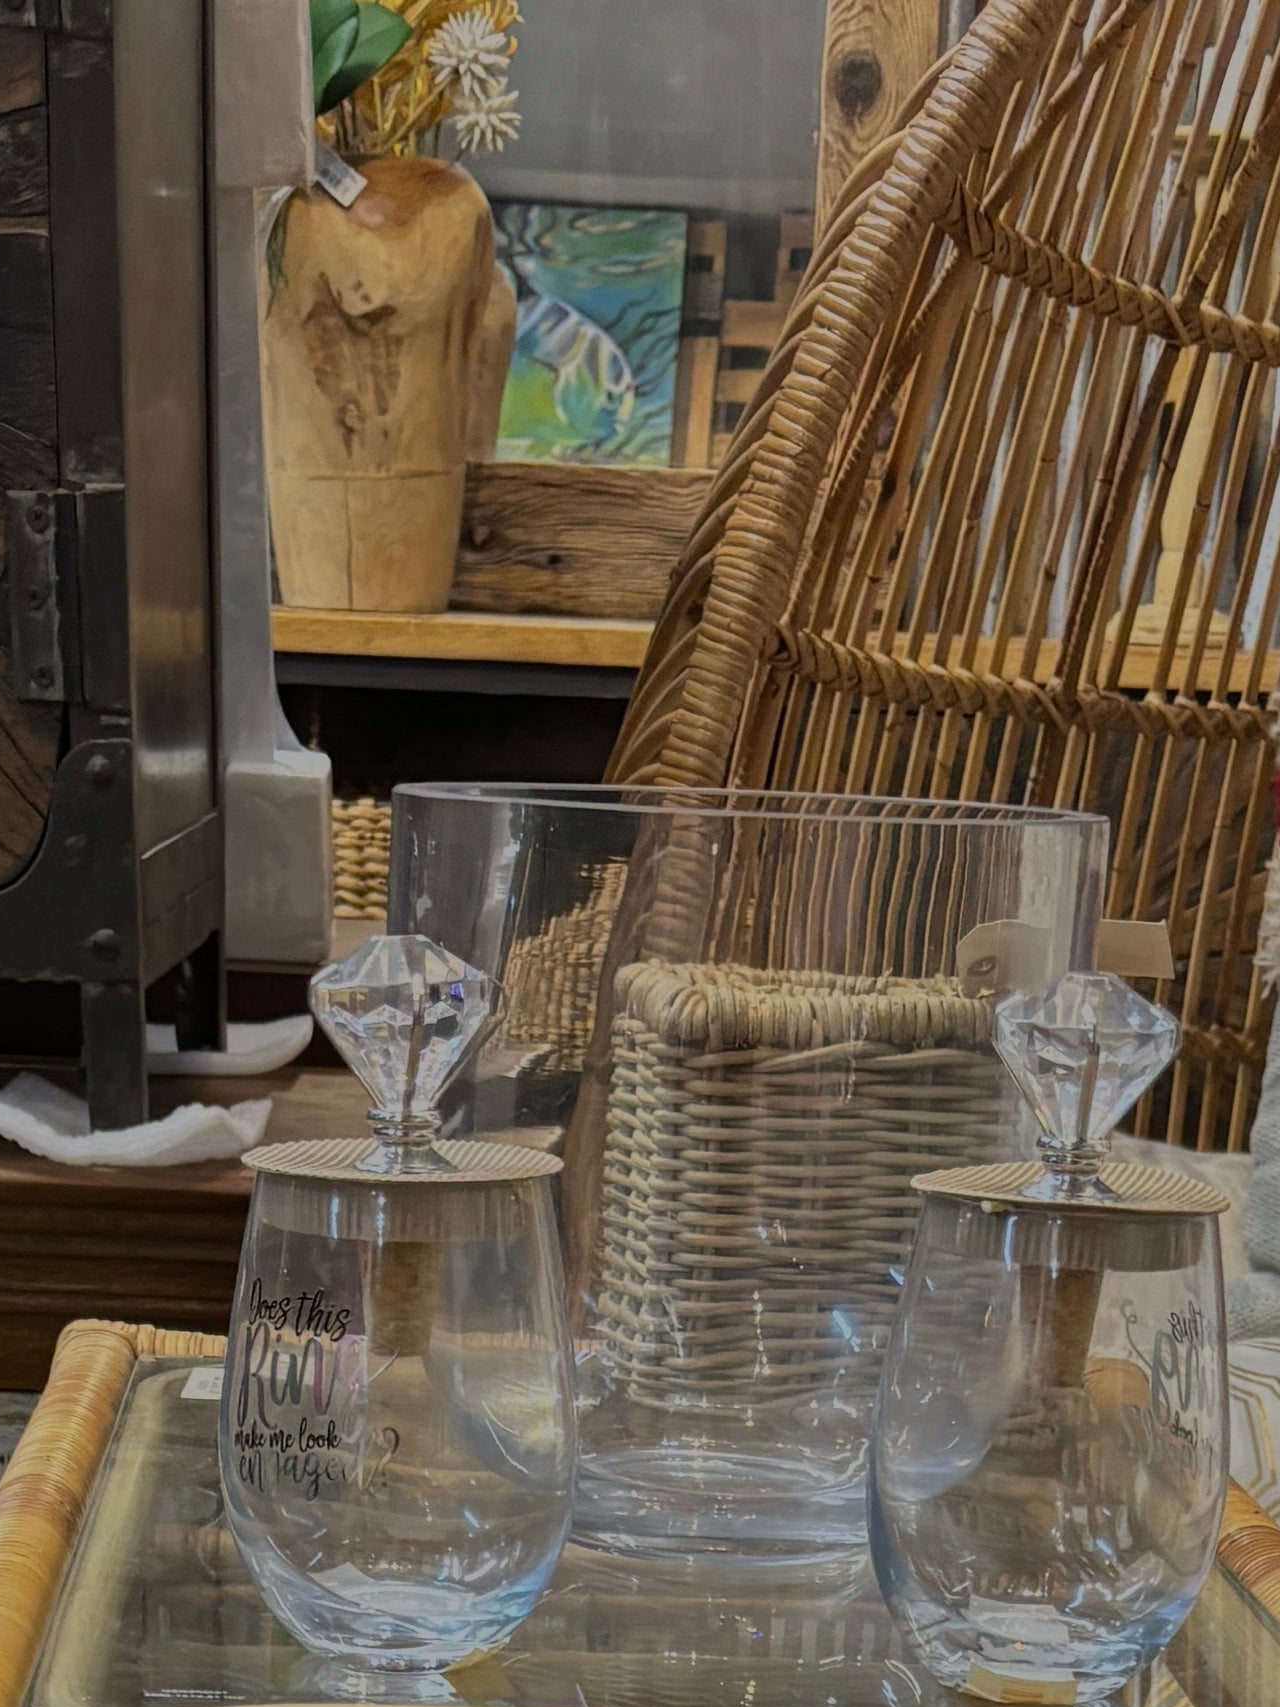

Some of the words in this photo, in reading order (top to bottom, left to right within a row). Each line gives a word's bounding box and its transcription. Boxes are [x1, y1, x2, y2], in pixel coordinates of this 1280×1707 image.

[250, 1277, 293, 1330] Does
[296, 1289, 352, 1342] this
[234, 1420, 266, 1450] make
[270, 1427, 294, 1453] me
[298, 1417, 342, 1452] look
